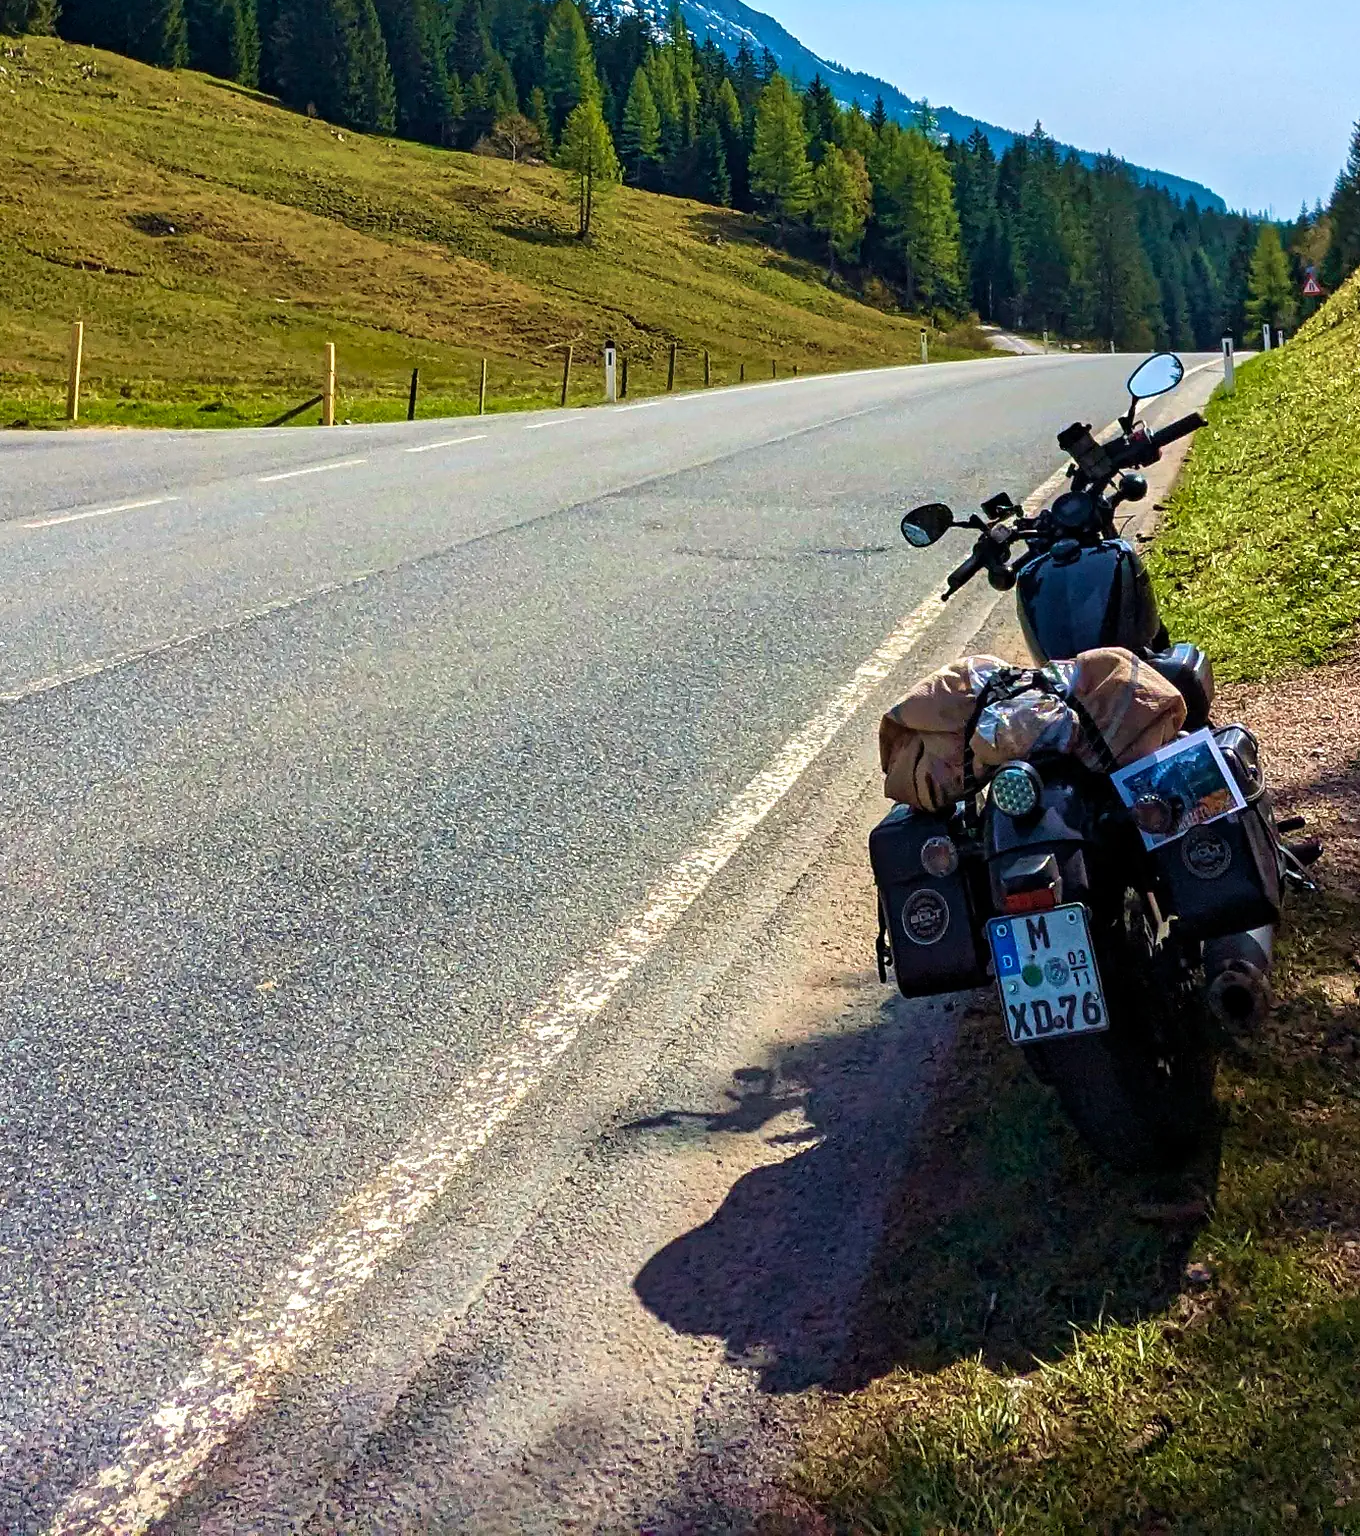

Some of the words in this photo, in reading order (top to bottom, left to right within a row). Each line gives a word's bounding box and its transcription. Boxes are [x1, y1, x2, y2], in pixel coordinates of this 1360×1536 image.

[1025, 915, 1051, 952] M
[1001, 954, 1013, 969] D
[1067, 949, 1087, 966] 03
